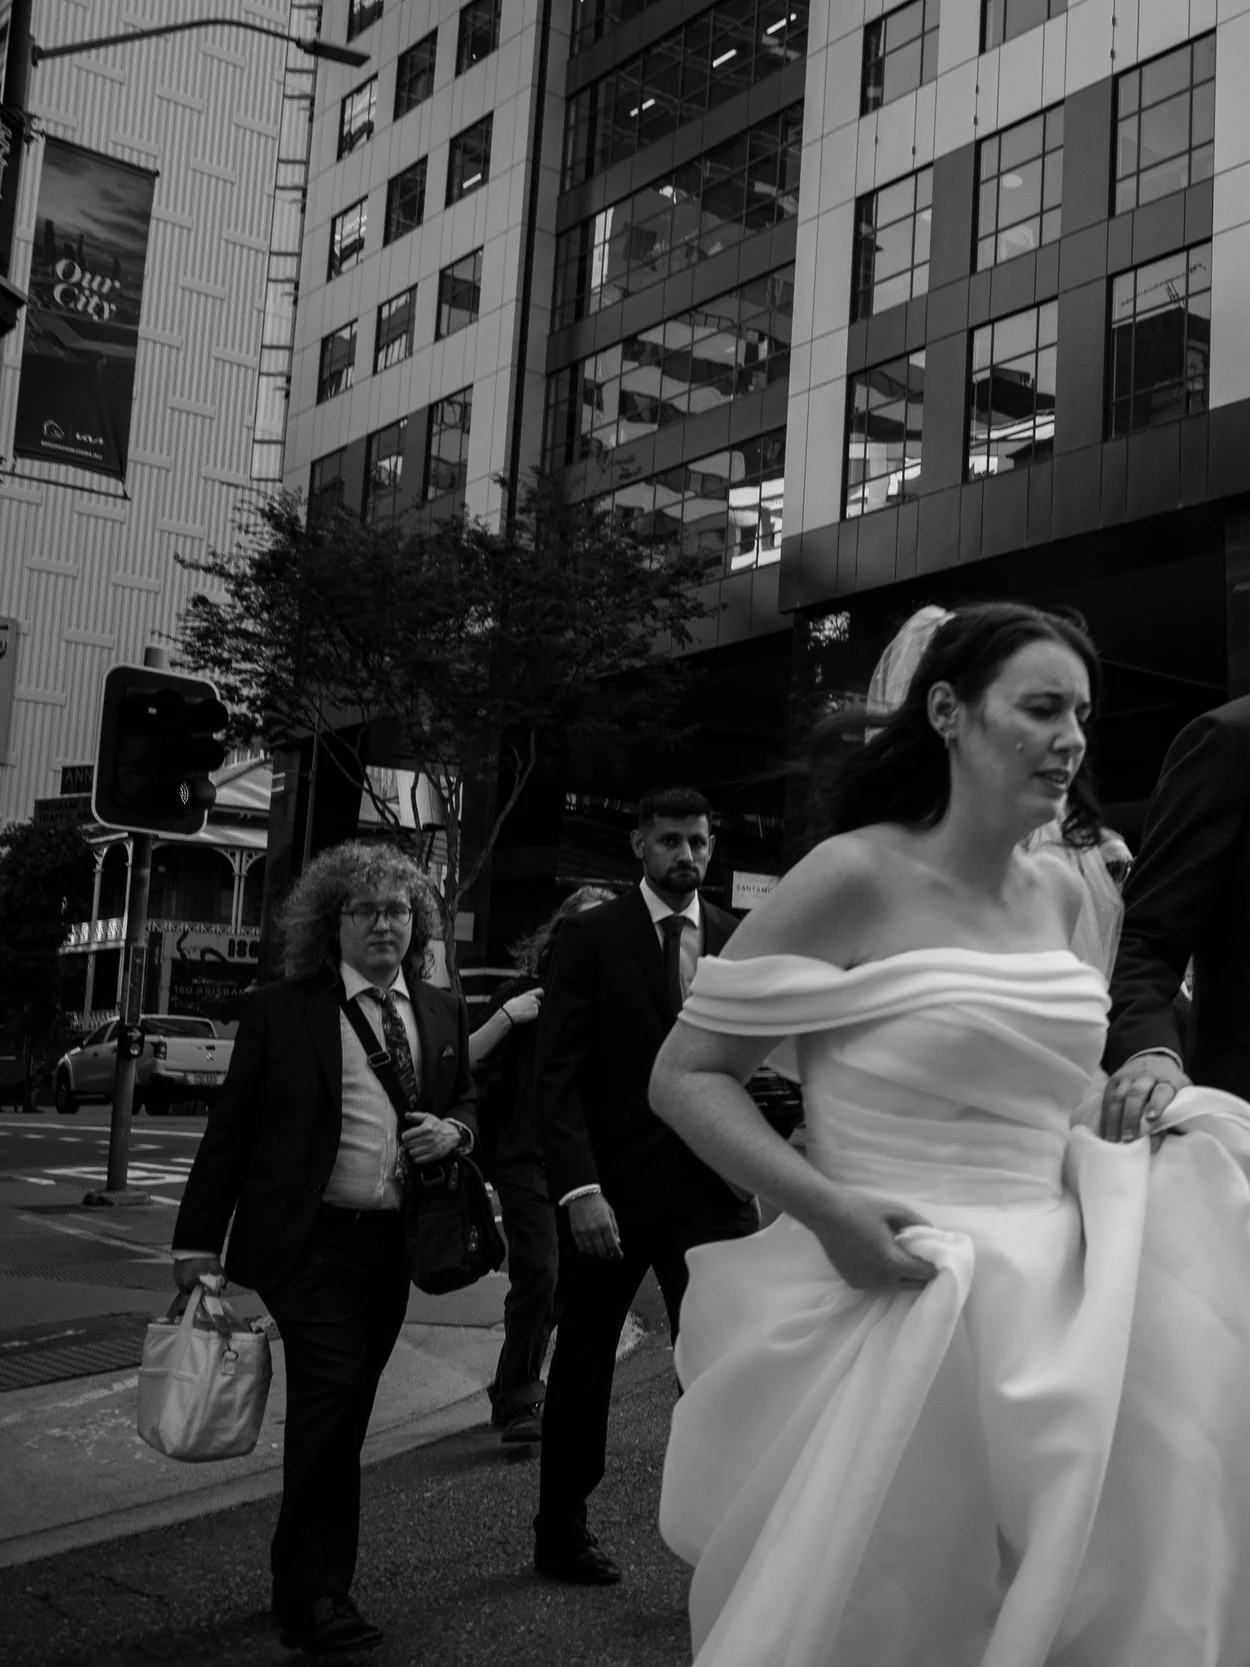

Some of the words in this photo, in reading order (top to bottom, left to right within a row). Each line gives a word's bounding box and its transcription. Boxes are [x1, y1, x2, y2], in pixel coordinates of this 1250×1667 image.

[55, 258, 121, 294] Our
[53, 282, 117, 321] City
[736, 884, 773, 894] SANTAM
